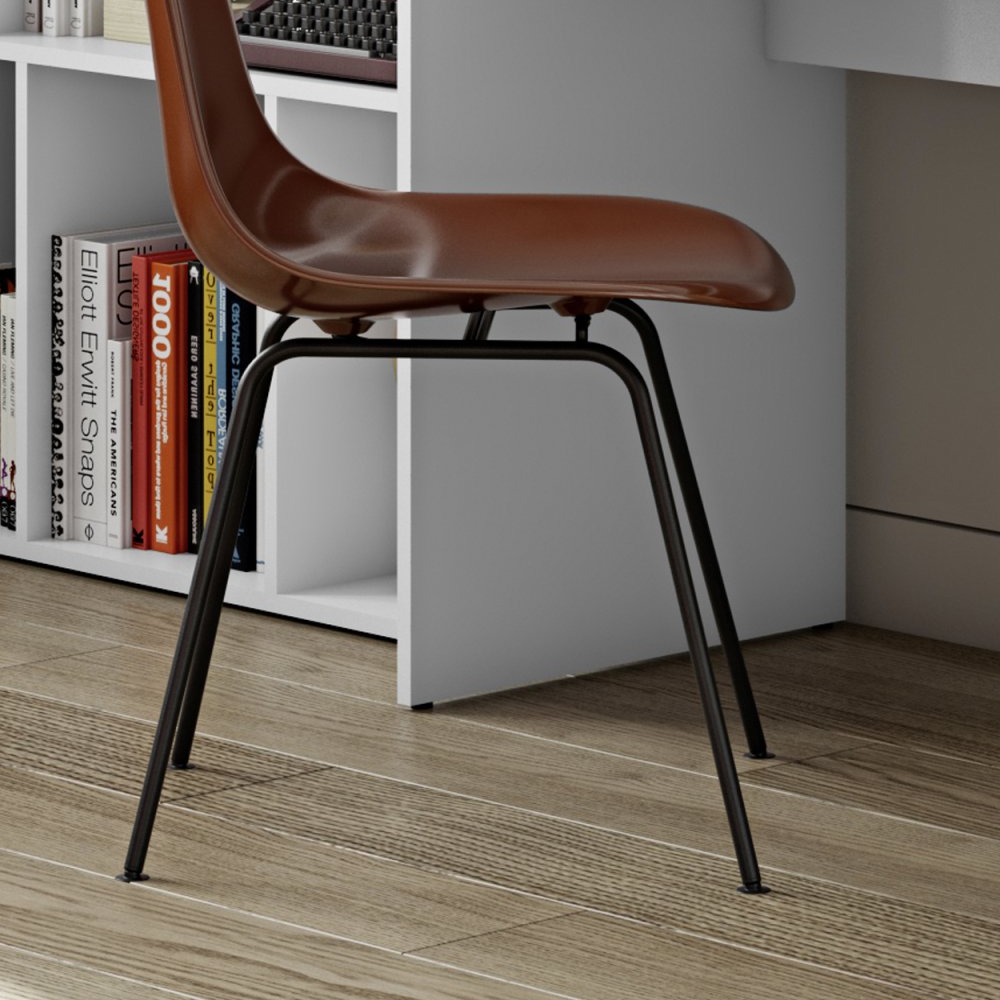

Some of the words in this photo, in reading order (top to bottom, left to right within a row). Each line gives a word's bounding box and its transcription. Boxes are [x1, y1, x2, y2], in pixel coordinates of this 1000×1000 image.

[81, 250, 99, 322] Elliott
[81, 331, 99, 408] Erwitt
[77, 418, 99, 506] Snaps
